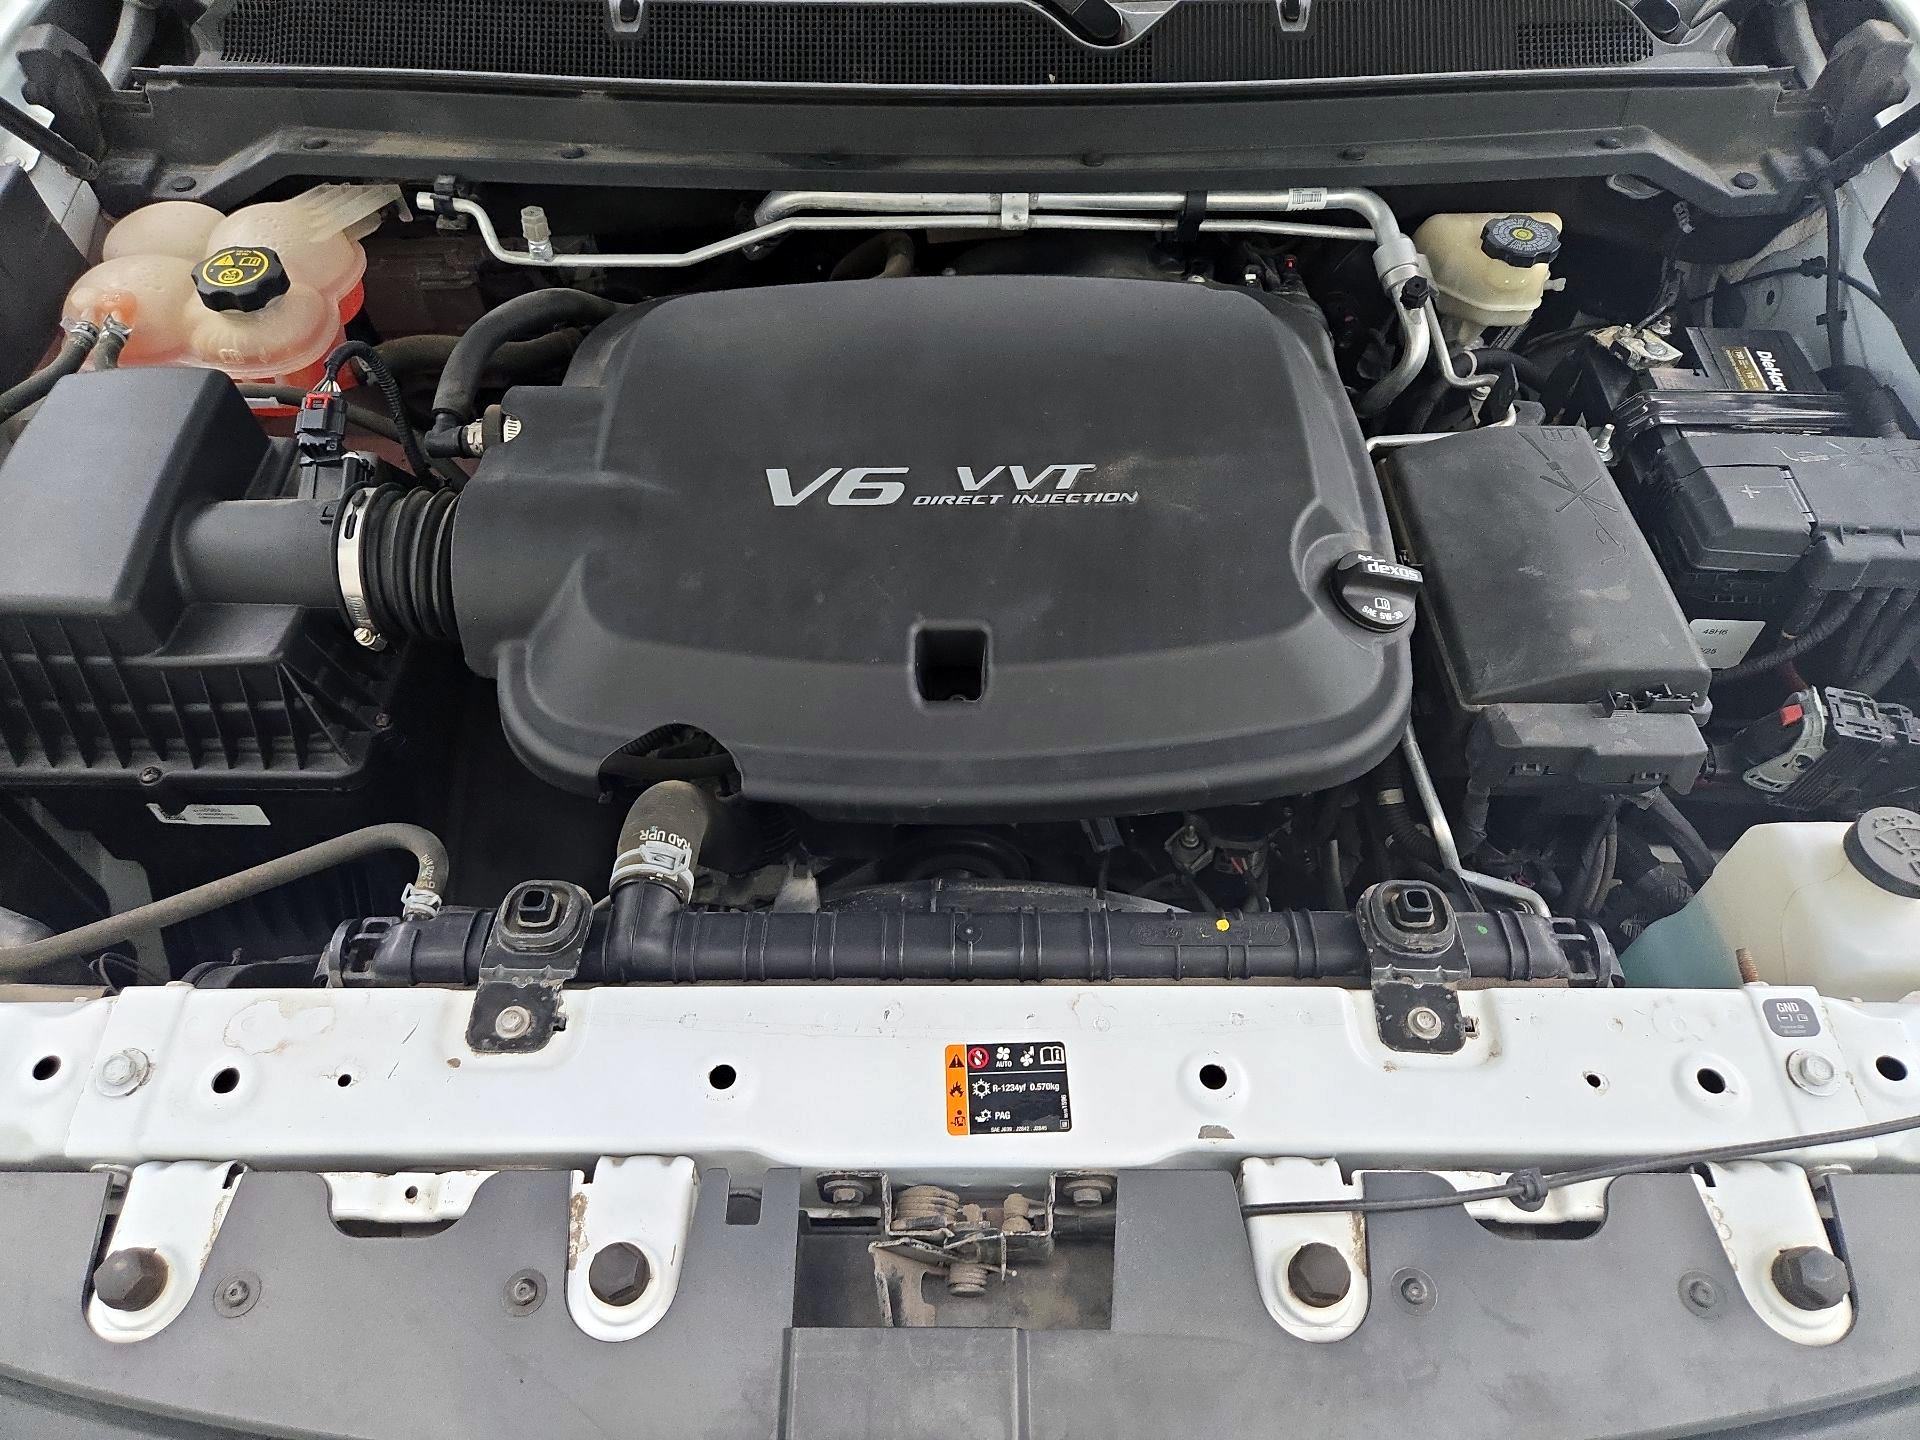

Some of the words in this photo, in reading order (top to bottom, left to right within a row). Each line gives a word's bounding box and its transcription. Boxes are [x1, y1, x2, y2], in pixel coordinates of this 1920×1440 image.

[957, 464, 1096, 491] VVT
[765, 467, 910, 507] V6
[912, 494, 1004, 507] DIRECT
[1011, 491, 1139, 505] INJECTION
[1367, 561, 1419, 581] dexos
[1361, 605, 1378, 618] SAE
[639, 829, 666, 842] UPR
[667, 832, 691, 850] RAD
[1776, 1002, 1800, 1013] GND
[995, 1060, 1013, 1068] AUTO
[992, 1084, 1027, 1093] R-1234yf
[1029, 1082, 1060, 1092] 0.570kg
[994, 1110, 1011, 1120] PAG
